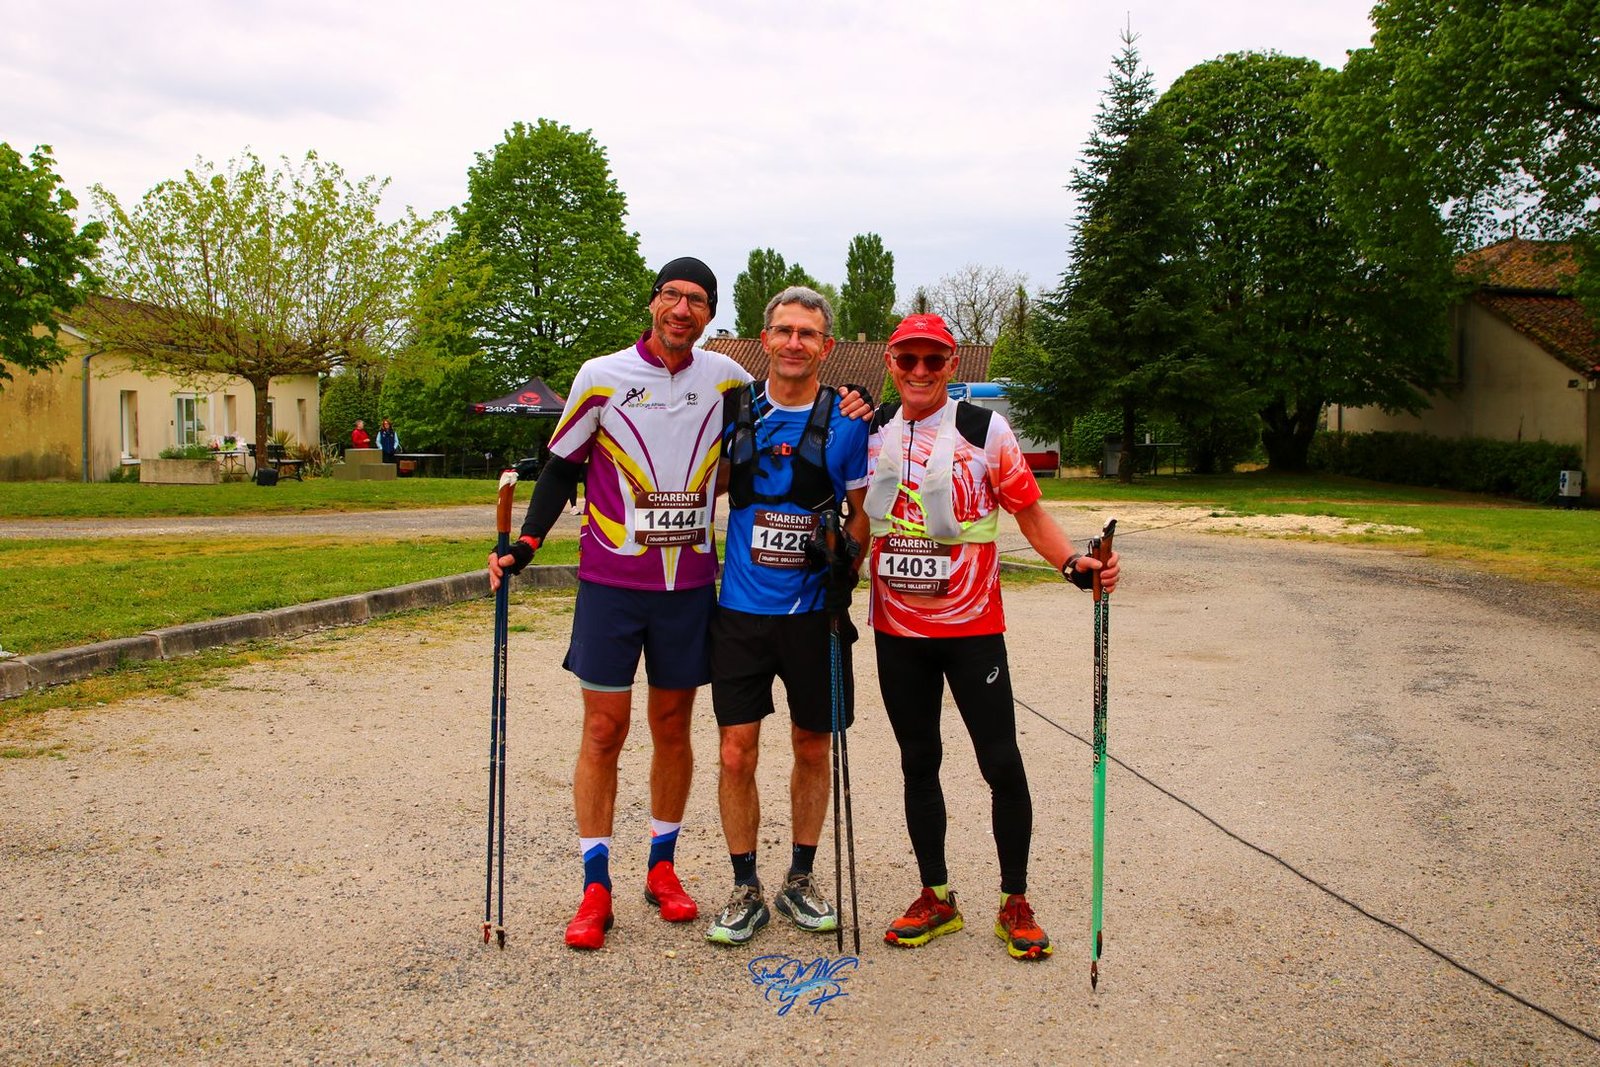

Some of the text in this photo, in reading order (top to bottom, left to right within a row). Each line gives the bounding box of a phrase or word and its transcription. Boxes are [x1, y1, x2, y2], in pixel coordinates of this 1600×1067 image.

[647, 493, 700, 502] CHARENTE
[645, 510, 697, 529] 1444
[765, 512, 812, 525] CHARENTE
[889, 538, 939, 549] CHARENTE
[885, 556, 937, 577] 1403
